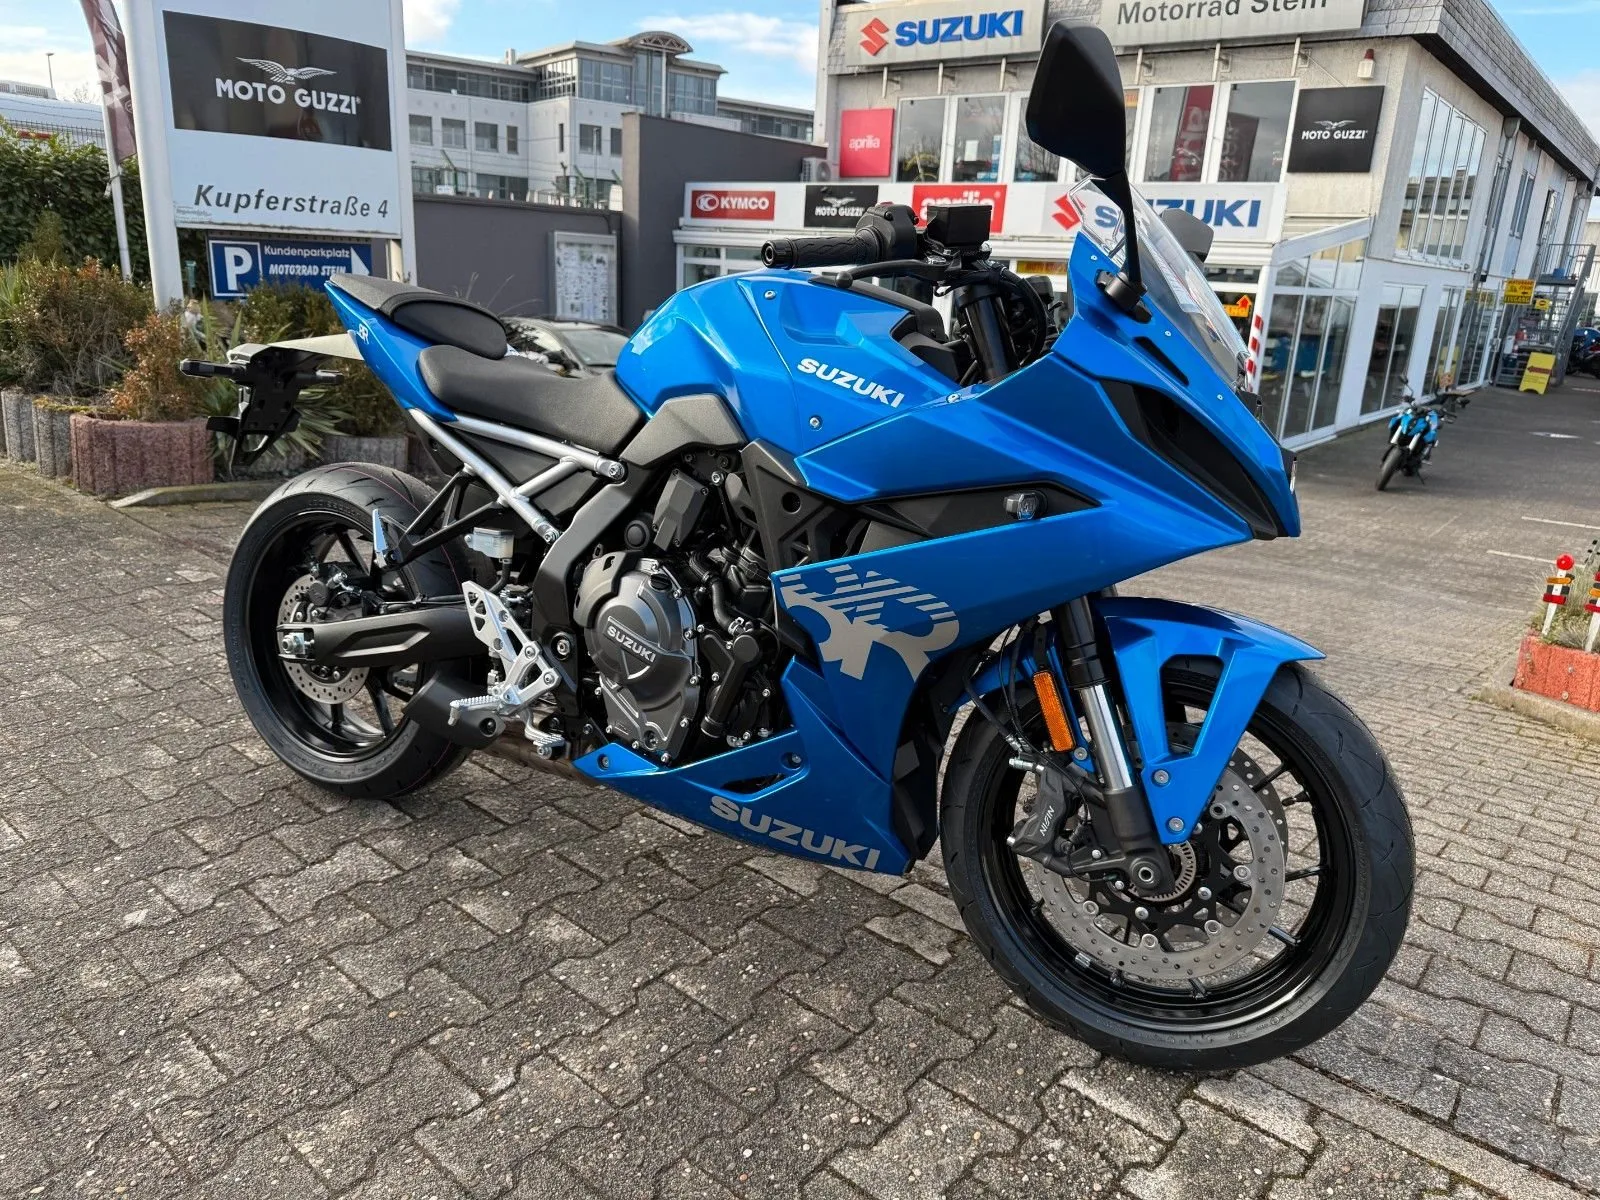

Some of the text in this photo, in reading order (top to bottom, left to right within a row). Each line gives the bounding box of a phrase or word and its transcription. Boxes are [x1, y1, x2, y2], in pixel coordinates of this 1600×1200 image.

[1116, 0, 1240, 25] Motorrad
[895, 10, 1024, 47] SUZUKI
[215, 77, 357, 115] MOTO GUZZI
[848, 134, 881, 152] aprilia
[1301, 129, 1367, 140] MOTO GUZZI
[193, 184, 376, 217] Kupferstraße
[378, 199, 389, 218] 4
[720, 196, 770, 211] KYMCO
[814, 206, 865, 217] MOTO GUZZI
[919, 190, 996, 221] ailia
[1094, 199, 1261, 230] SUKI
[264, 245, 350, 259] Kundenparkplatz
[223, 246, 253, 291] P
[268, 264, 347, 276] MOTORRAD STEIN
[797, 358, 905, 409] SUZUKI
[606, 625, 656, 663] SUZUKI
[709, 795, 881, 870] SUZUKI
